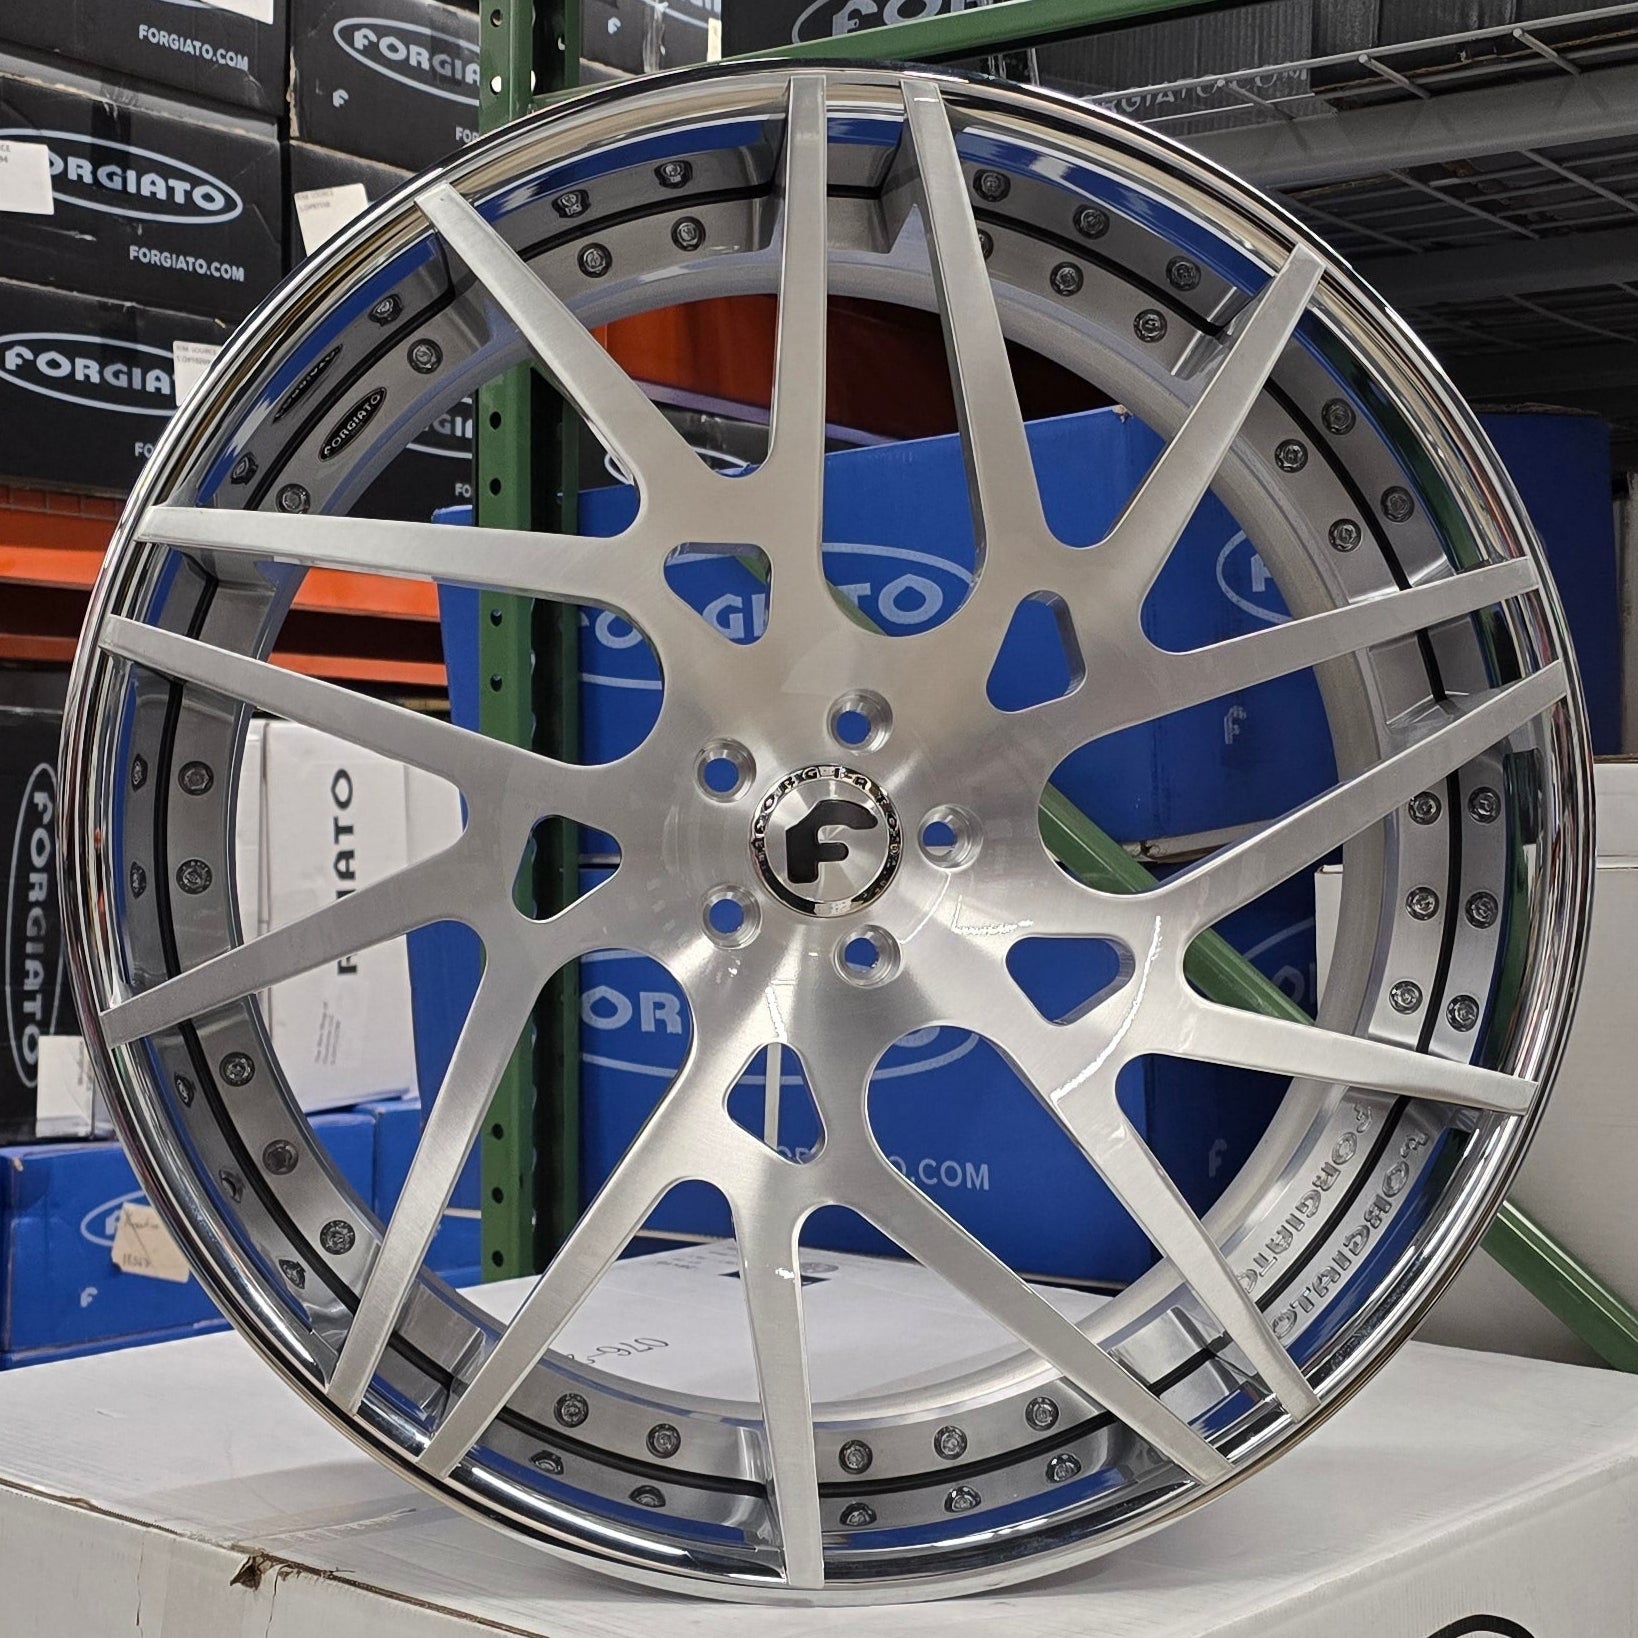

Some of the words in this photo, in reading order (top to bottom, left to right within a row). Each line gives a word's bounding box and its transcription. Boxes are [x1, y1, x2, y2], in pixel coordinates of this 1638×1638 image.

[139, 24, 249, 71] FORGIATO.COM
[129, 245, 245, 282] FORGIATO.COM
[5, 345, 175, 395] FORGIA
[324, 394, 381, 456] FORGIATO
[22, 791, 51, 1066] FORGIATO
